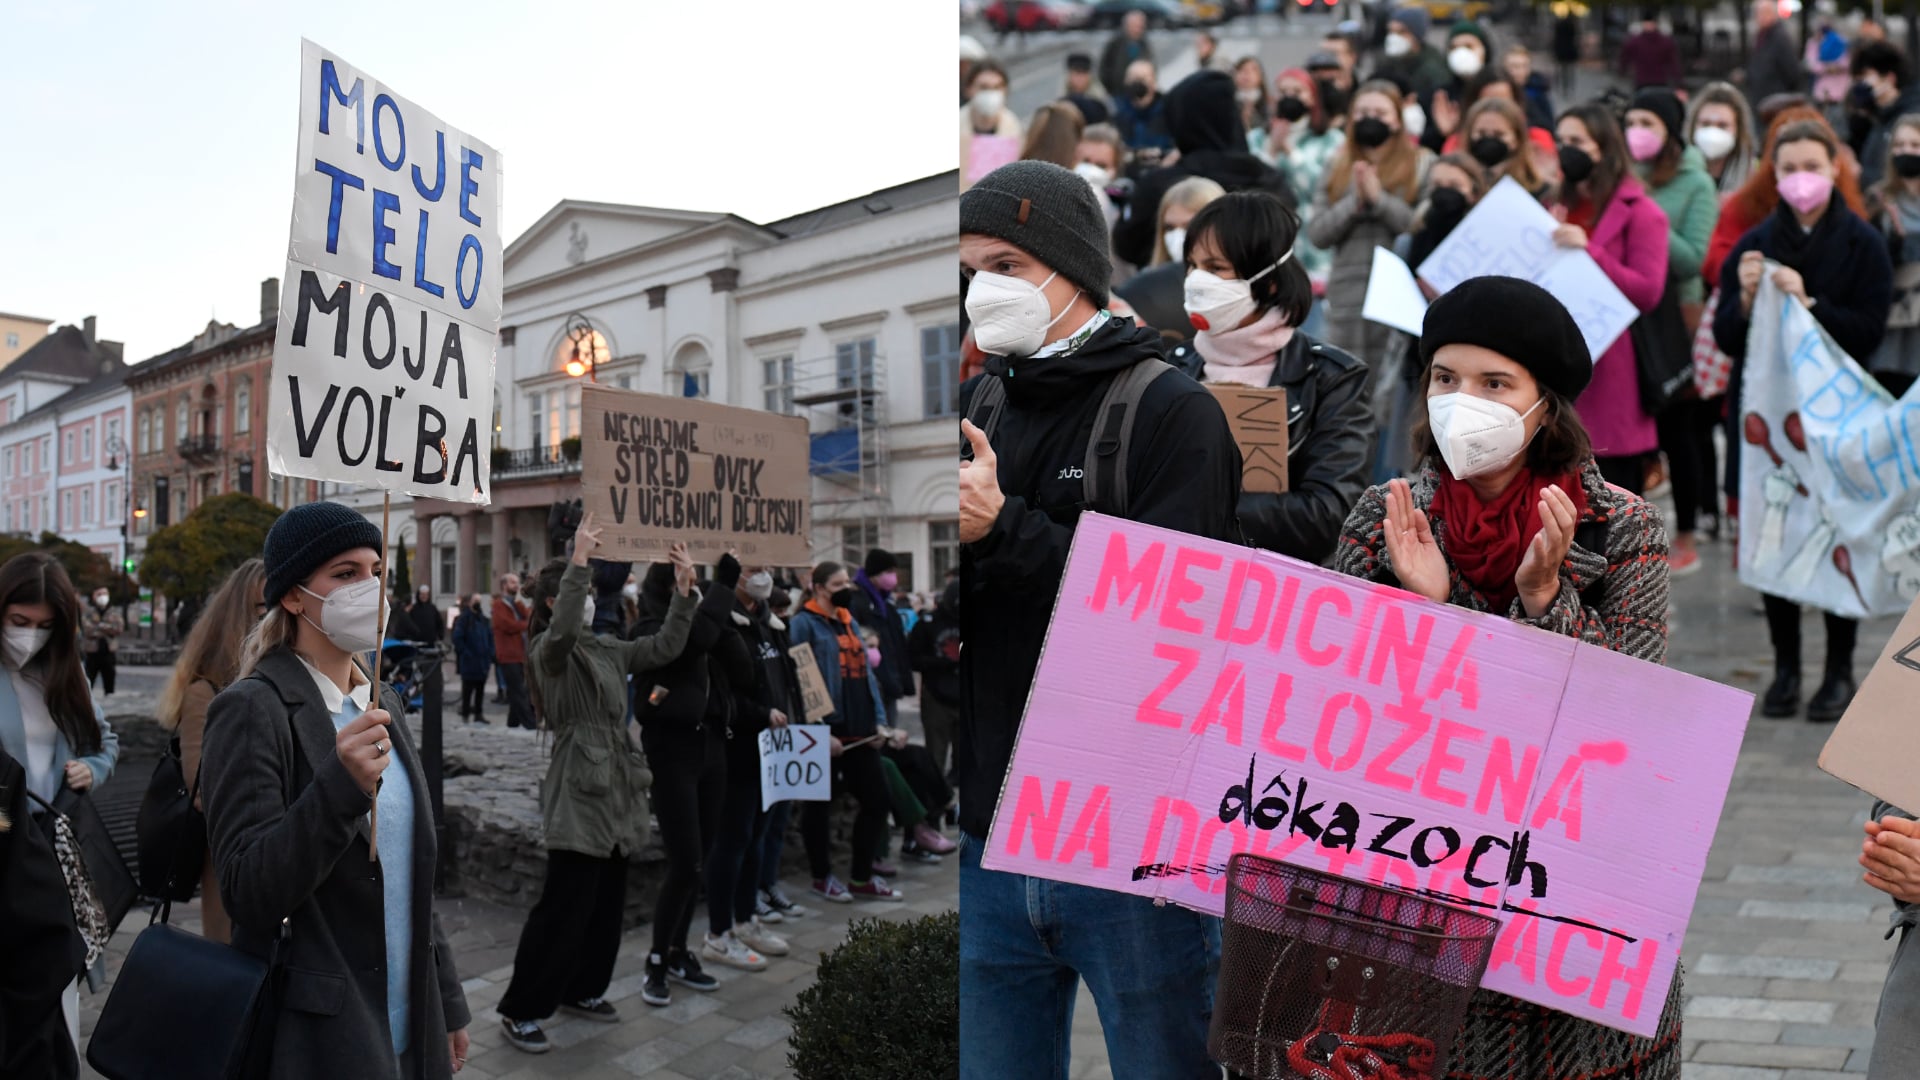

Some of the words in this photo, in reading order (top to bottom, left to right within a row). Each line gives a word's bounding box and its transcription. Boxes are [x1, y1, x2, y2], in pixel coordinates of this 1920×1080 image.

[319, 59, 483, 227] MOJE
[314, 158, 483, 310] TELO
[291, 270, 468, 399] MOJA
[288, 375, 483, 494] VOĽBA
[603, 410, 699, 452] NECHAJME
[609, 485, 628, 524] V
[638, 487, 722, 530] UČEBNICI
[1136, 643, 1628, 842] ZALOŽENÁ
[1005, 775, 1111, 869] NA
[1219, 752, 1548, 898] dôkazoch
